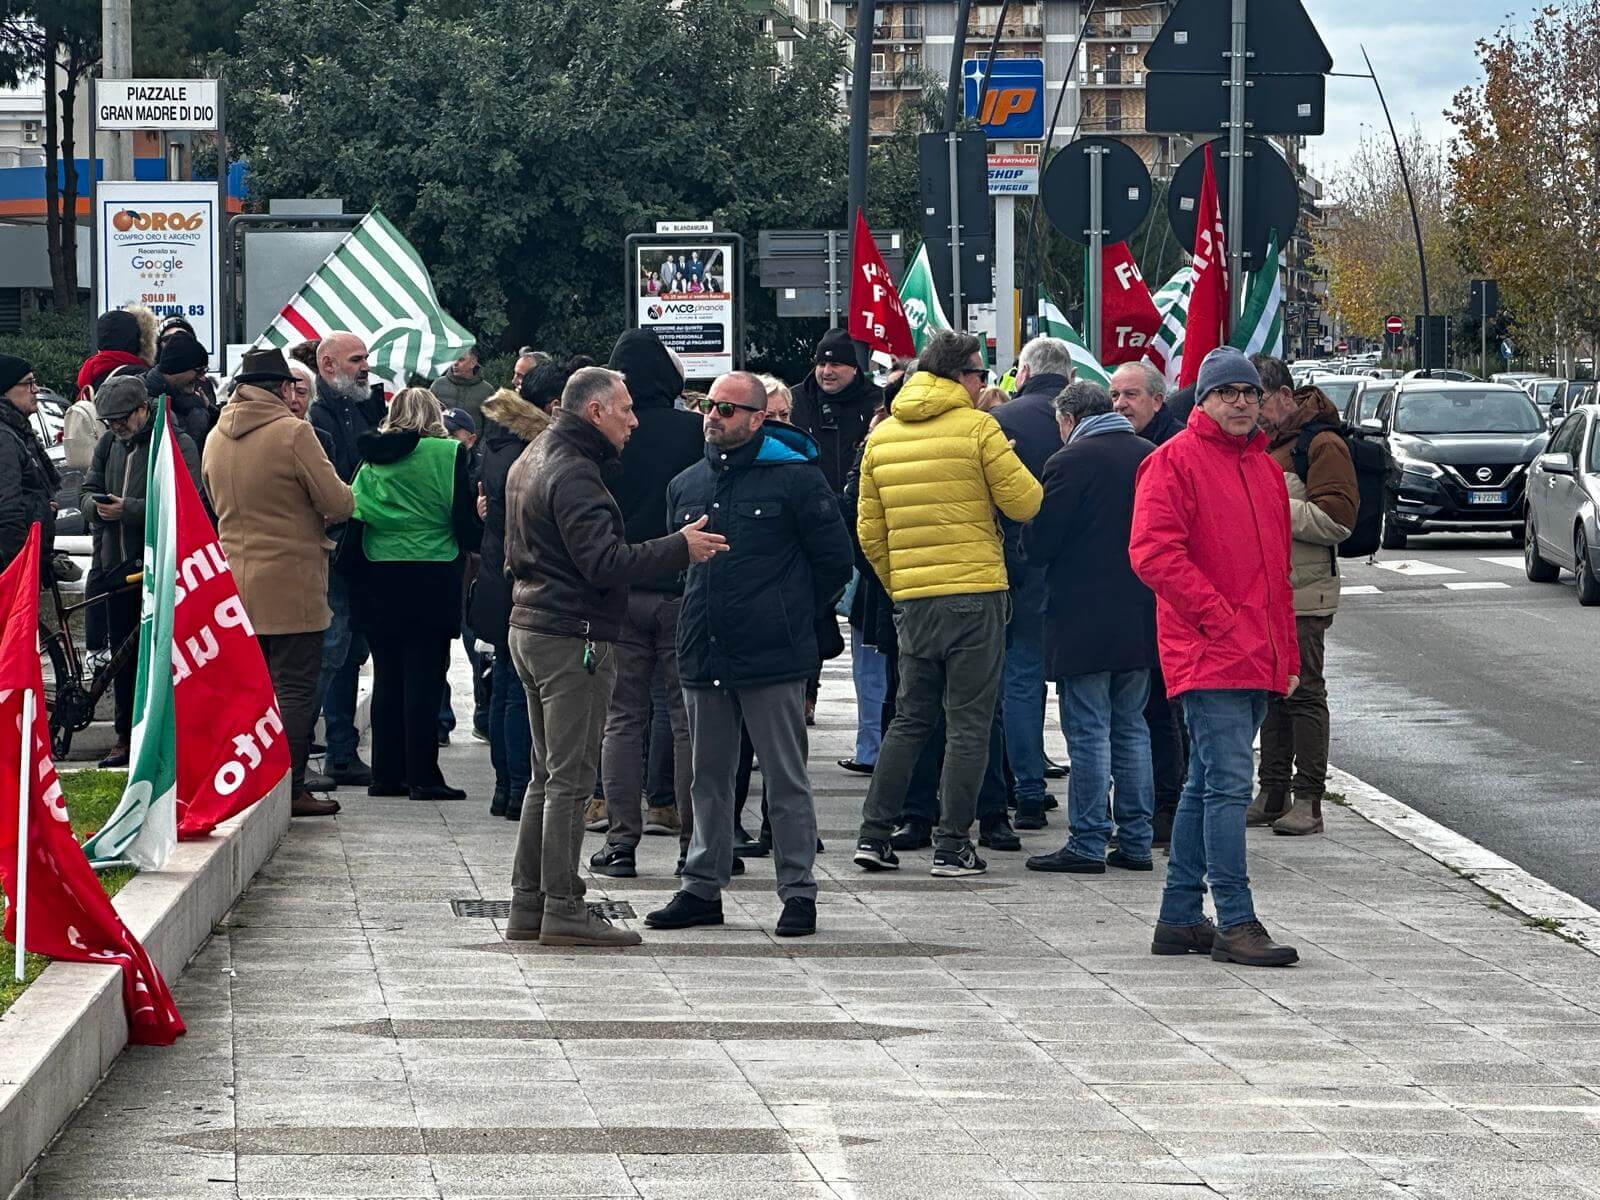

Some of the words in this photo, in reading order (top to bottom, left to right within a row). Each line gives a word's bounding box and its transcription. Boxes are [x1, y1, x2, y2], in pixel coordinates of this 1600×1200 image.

[127, 87, 187, 101] PIAZZALE
[100, 105, 133, 121] GRAN
[135, 105, 177, 121] MADRE
[180, 106, 191, 121] DI
[193, 106, 214, 121] DIO
[980, 88, 1036, 125] IP
[986, 170, 1024, 179] SHOP
[113, 233, 144, 241] COMPRO
[145, 233, 162, 241] ORO
[163, 233, 168, 241] E
[168, 233, 201, 241] ARGENTO
[131, 255, 183, 273] Google
[153, 280, 165, 288] 4,7
[141, 293, 164, 303] SOLO
[166, 293, 177, 303] IN
[151, 305, 187, 317] PINO,
[188, 304, 205, 316] 83
